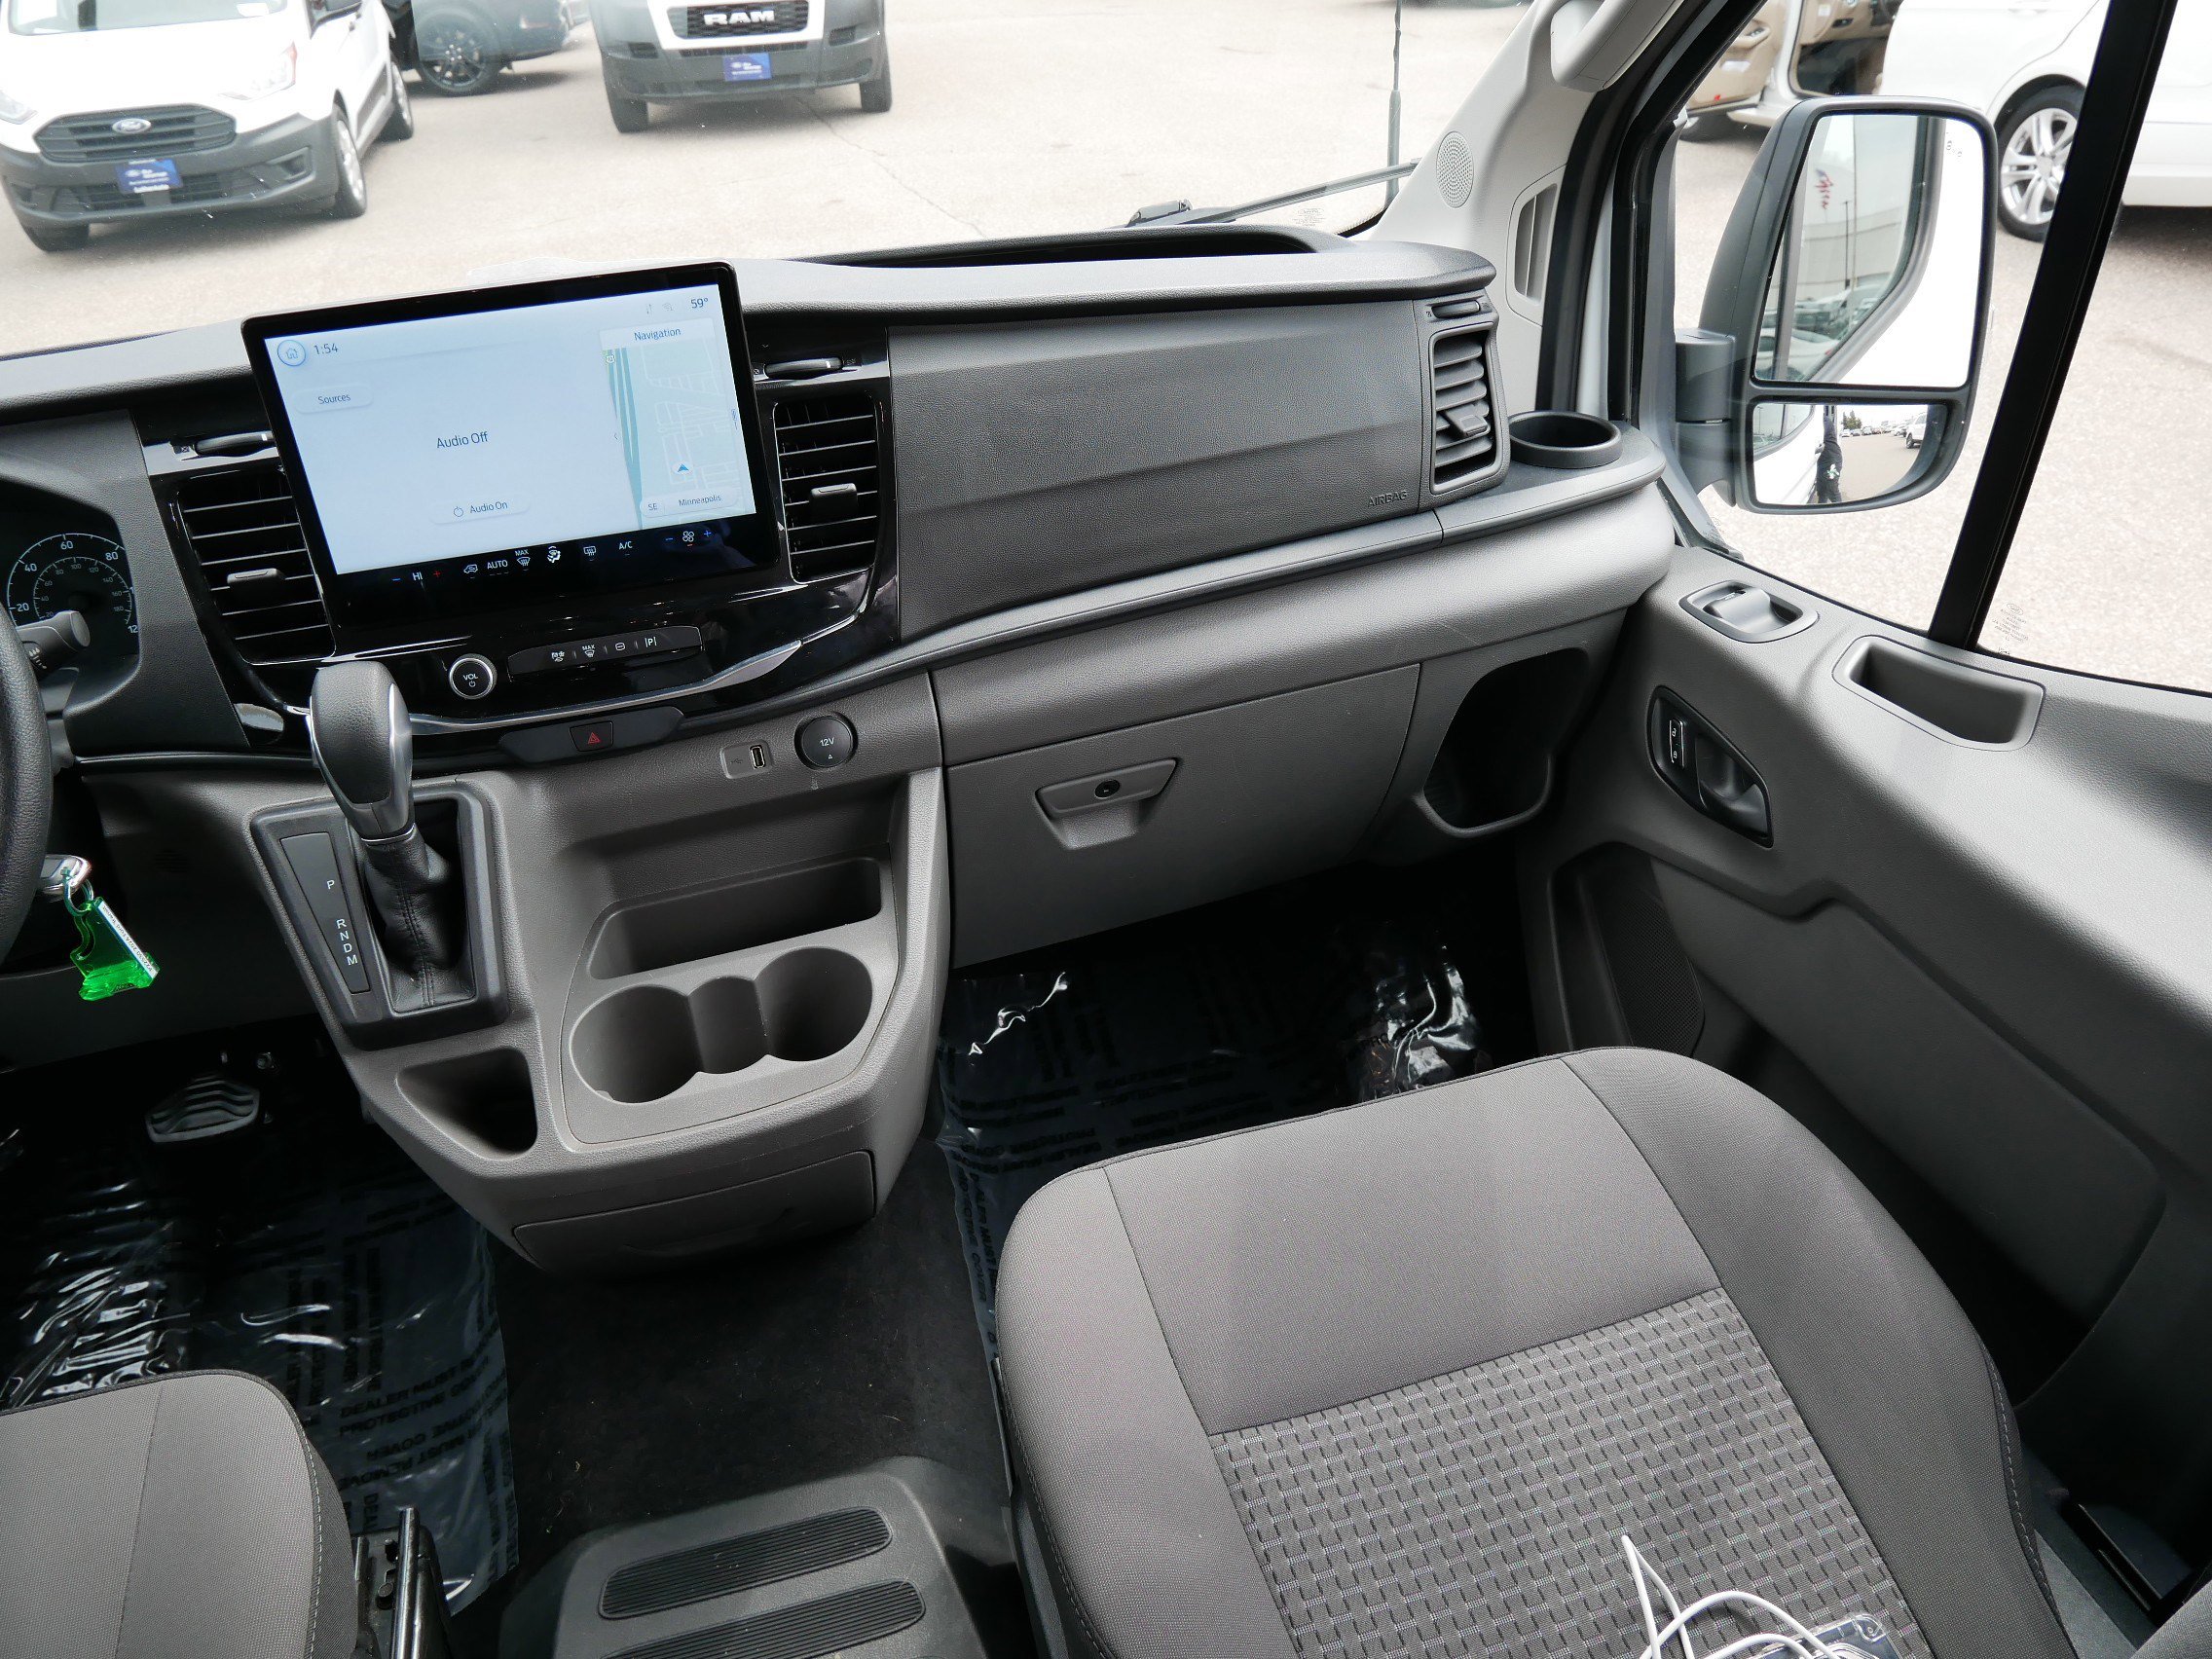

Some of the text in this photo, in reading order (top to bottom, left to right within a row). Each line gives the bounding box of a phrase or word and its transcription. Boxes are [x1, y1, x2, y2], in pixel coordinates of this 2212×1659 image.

[703, 10, 775, 25] RAM
[634, 327, 682, 341] Navigation
[313, 343, 339, 355] 1:54
[317, 392, 351, 405] Sources
[436, 430, 488, 448] Audio Off
[678, 495, 722, 507] Minneapolis
[1368, 490, 1408, 507] AIRBAG
[470, 501, 508, 514] Audio On
[647, 502, 658, 511] SE
[60, 541, 73, 550] 60
[618, 540, 633, 551] A/C
[105, 551, 118, 561] 80
[514, 548, 530, 557] MAX
[24, 563, 37, 572] 40
[487, 559, 508, 570] AUTO
[412, 571, 424, 581] HI
[17, 603, 29, 611] 20
[819, 737, 835, 747] 12V
[327, 880, 335, 890] P
[336, 919, 347, 929] R
[340, 932, 350, 940] N
[344, 943, 352, 953] D
[347, 955, 358, 966] M
[341, 1389, 409, 1418] DEALER
